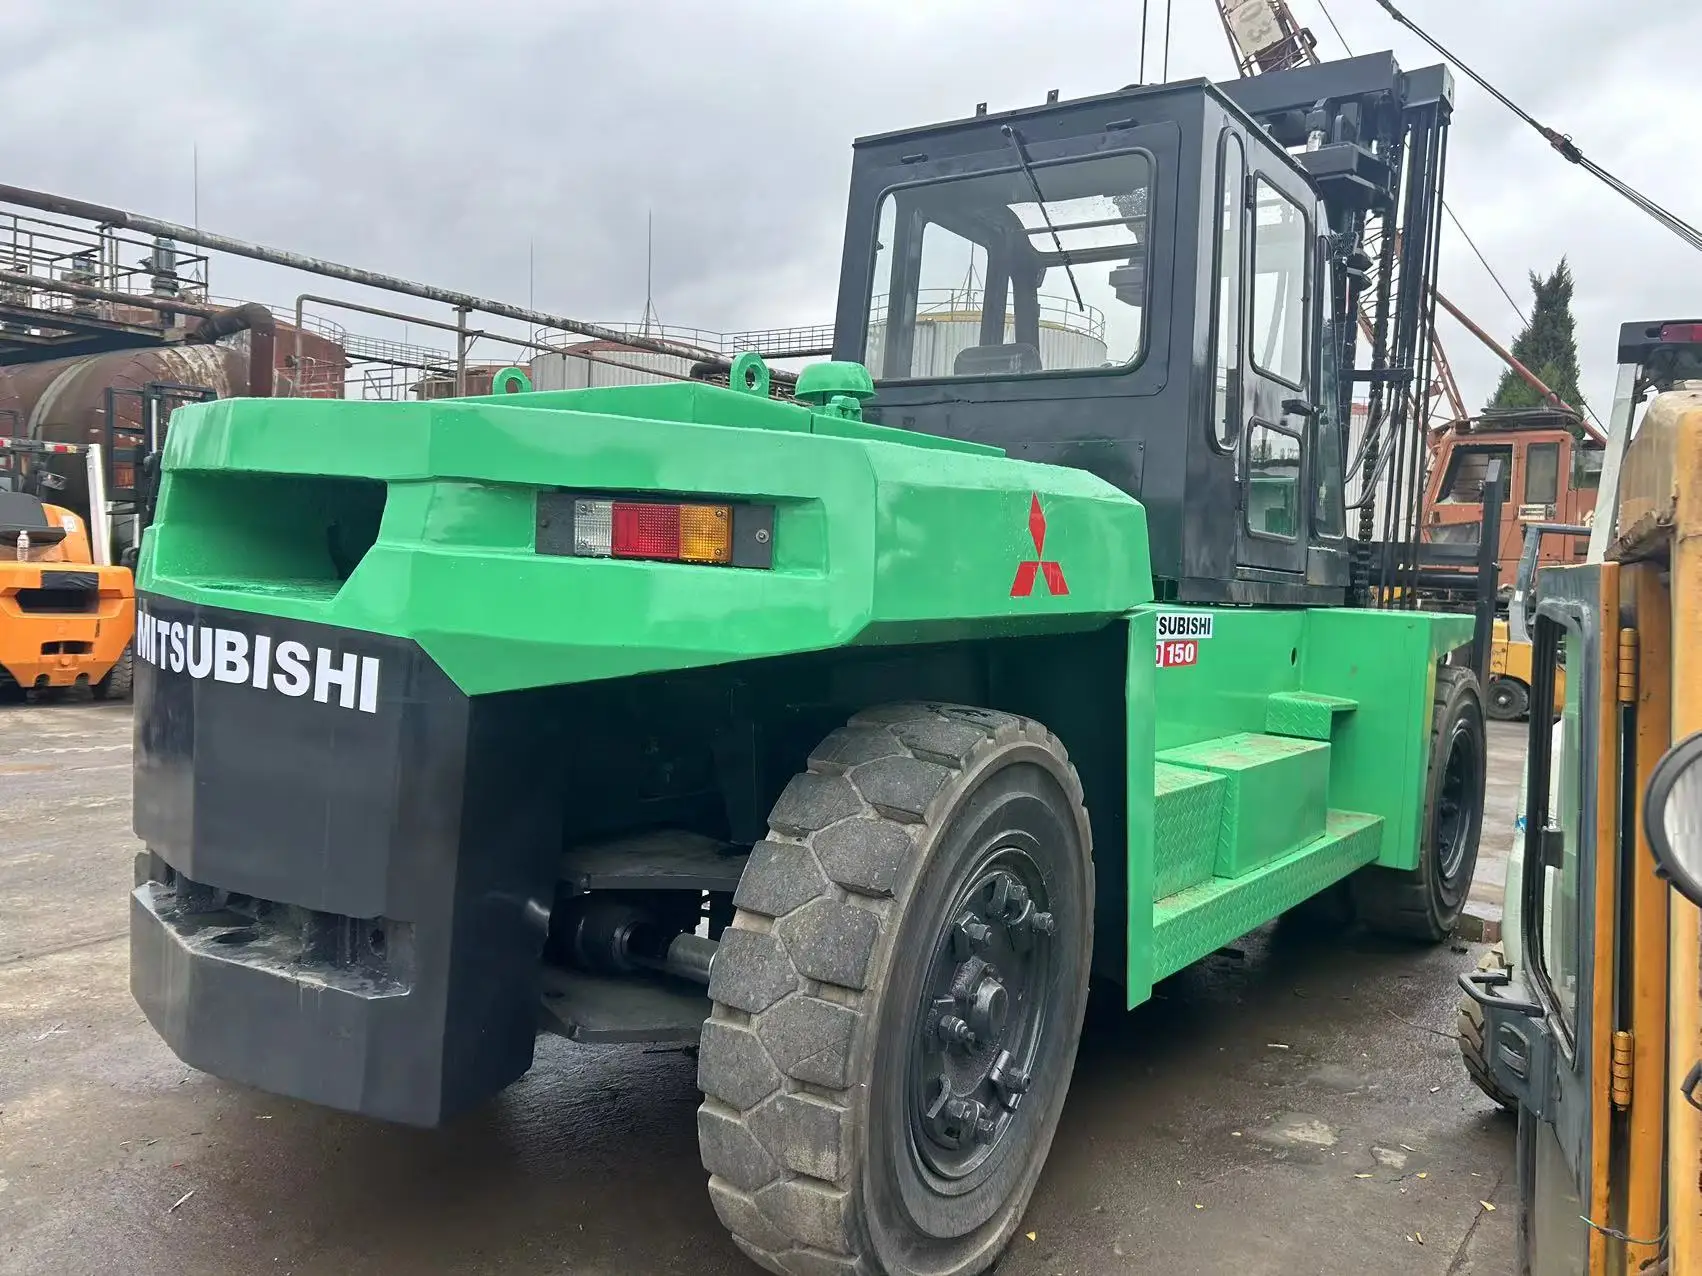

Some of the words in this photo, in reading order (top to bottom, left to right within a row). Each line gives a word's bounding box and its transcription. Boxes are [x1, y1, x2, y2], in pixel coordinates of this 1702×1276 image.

[1156, 616, 1211, 635] SUBISHI
[137, 610, 380, 714] MITSUBISHI
[1167, 643, 1195, 664] 150
